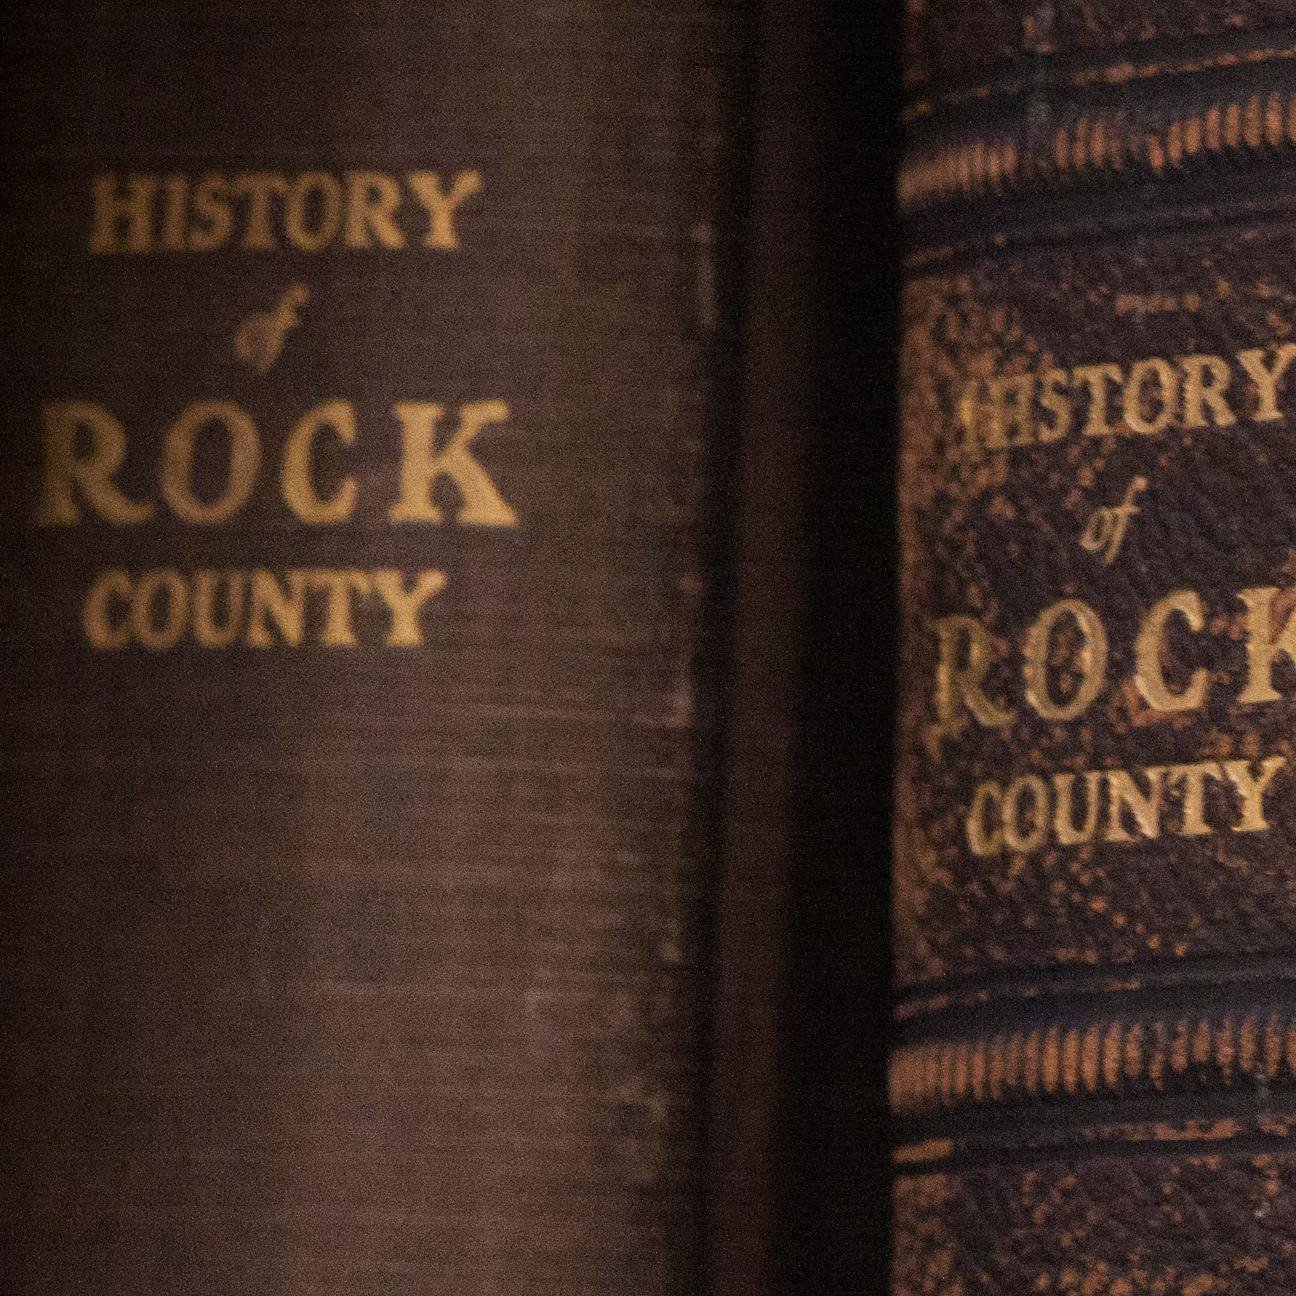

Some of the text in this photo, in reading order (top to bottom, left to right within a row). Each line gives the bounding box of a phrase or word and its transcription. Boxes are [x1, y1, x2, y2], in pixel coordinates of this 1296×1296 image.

[90, 169, 483, 253] HISTORY
[232, 282, 310, 373] of
[37, 398, 517, 528] ROCK
[1080, 476, 1148, 565] of
[82, 568, 447, 651] COUNTY
[966, 756, 1287, 858] COUNTY
